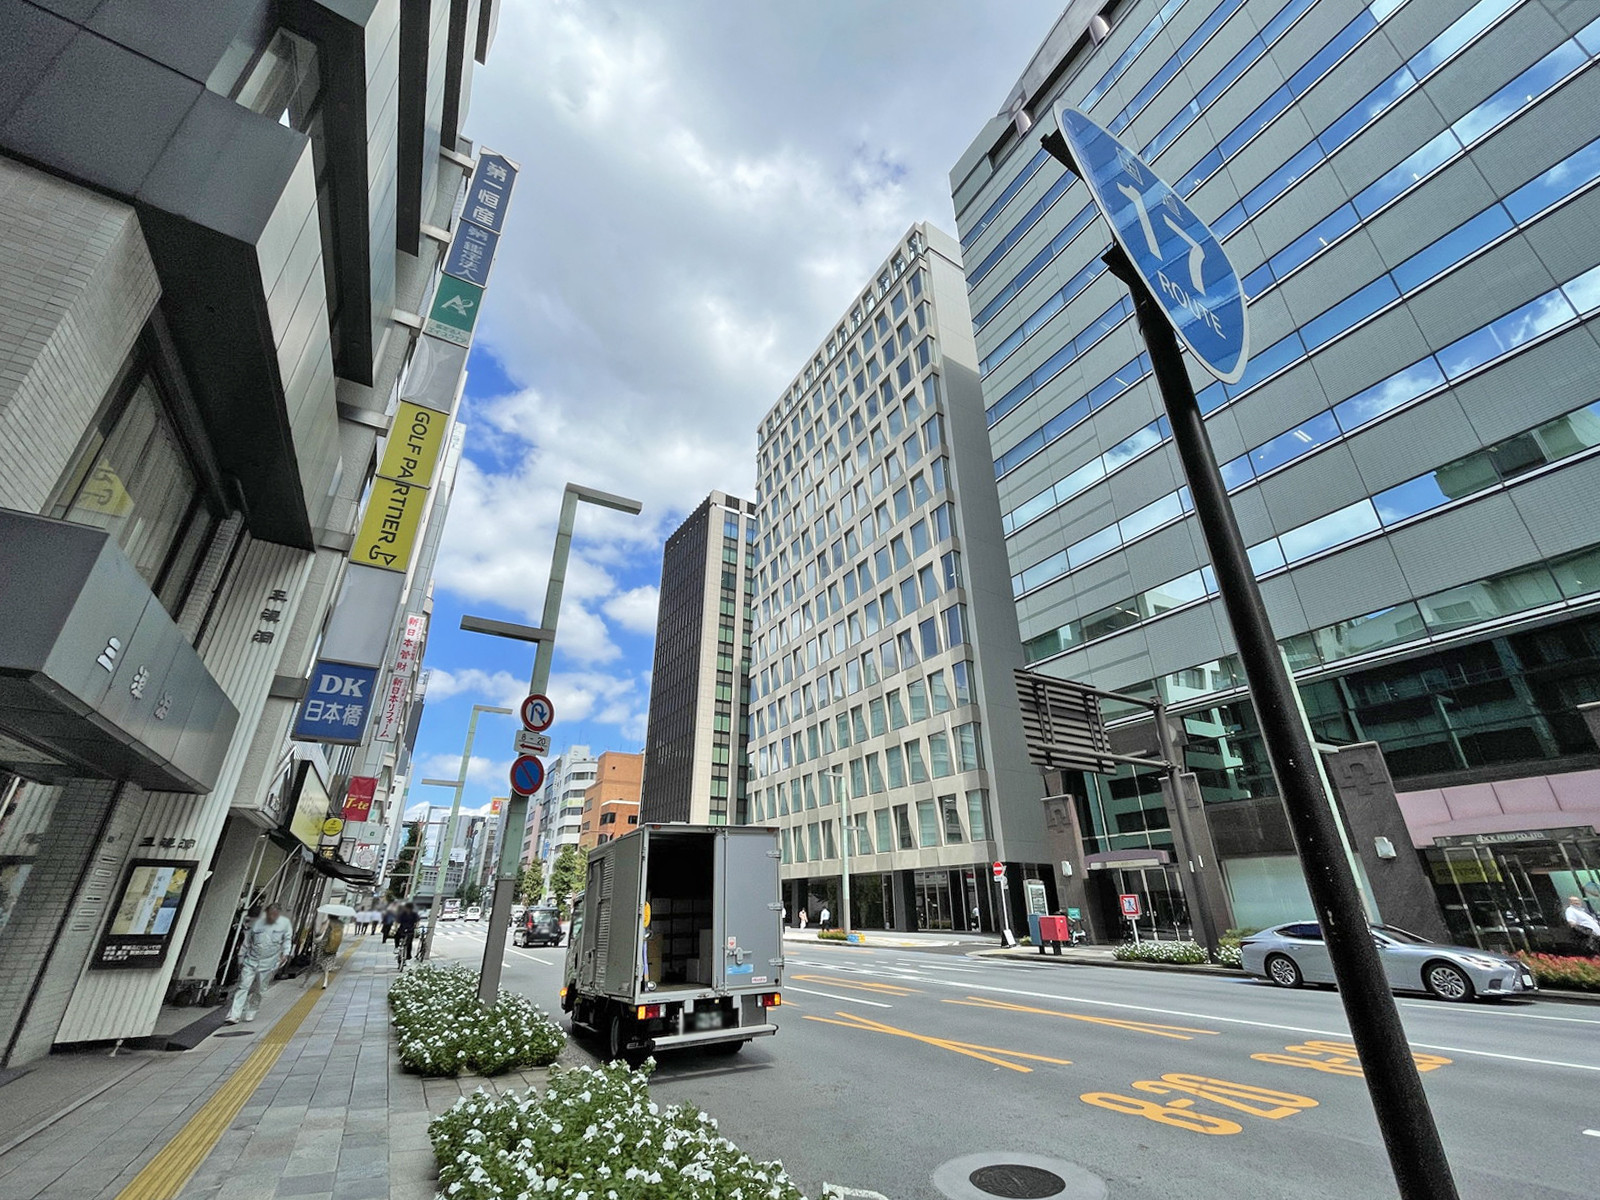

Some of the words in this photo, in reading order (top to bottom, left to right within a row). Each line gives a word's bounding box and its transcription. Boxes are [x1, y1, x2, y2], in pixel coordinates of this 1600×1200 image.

[472, 162, 507, 226] 第一恒産
[1116, 181, 1206, 297] 17
[1157, 270, 1227, 340] ROUTE
[407, 411, 430, 455] GOLF
[378, 457, 417, 544] PARTNER
[304, 699, 363, 727] 日本橋
[317, 674, 366, 698] DK
[379, 677, 403, 738] 新日本リフォーム
[1079, 1073, 1319, 1135] 8-20
